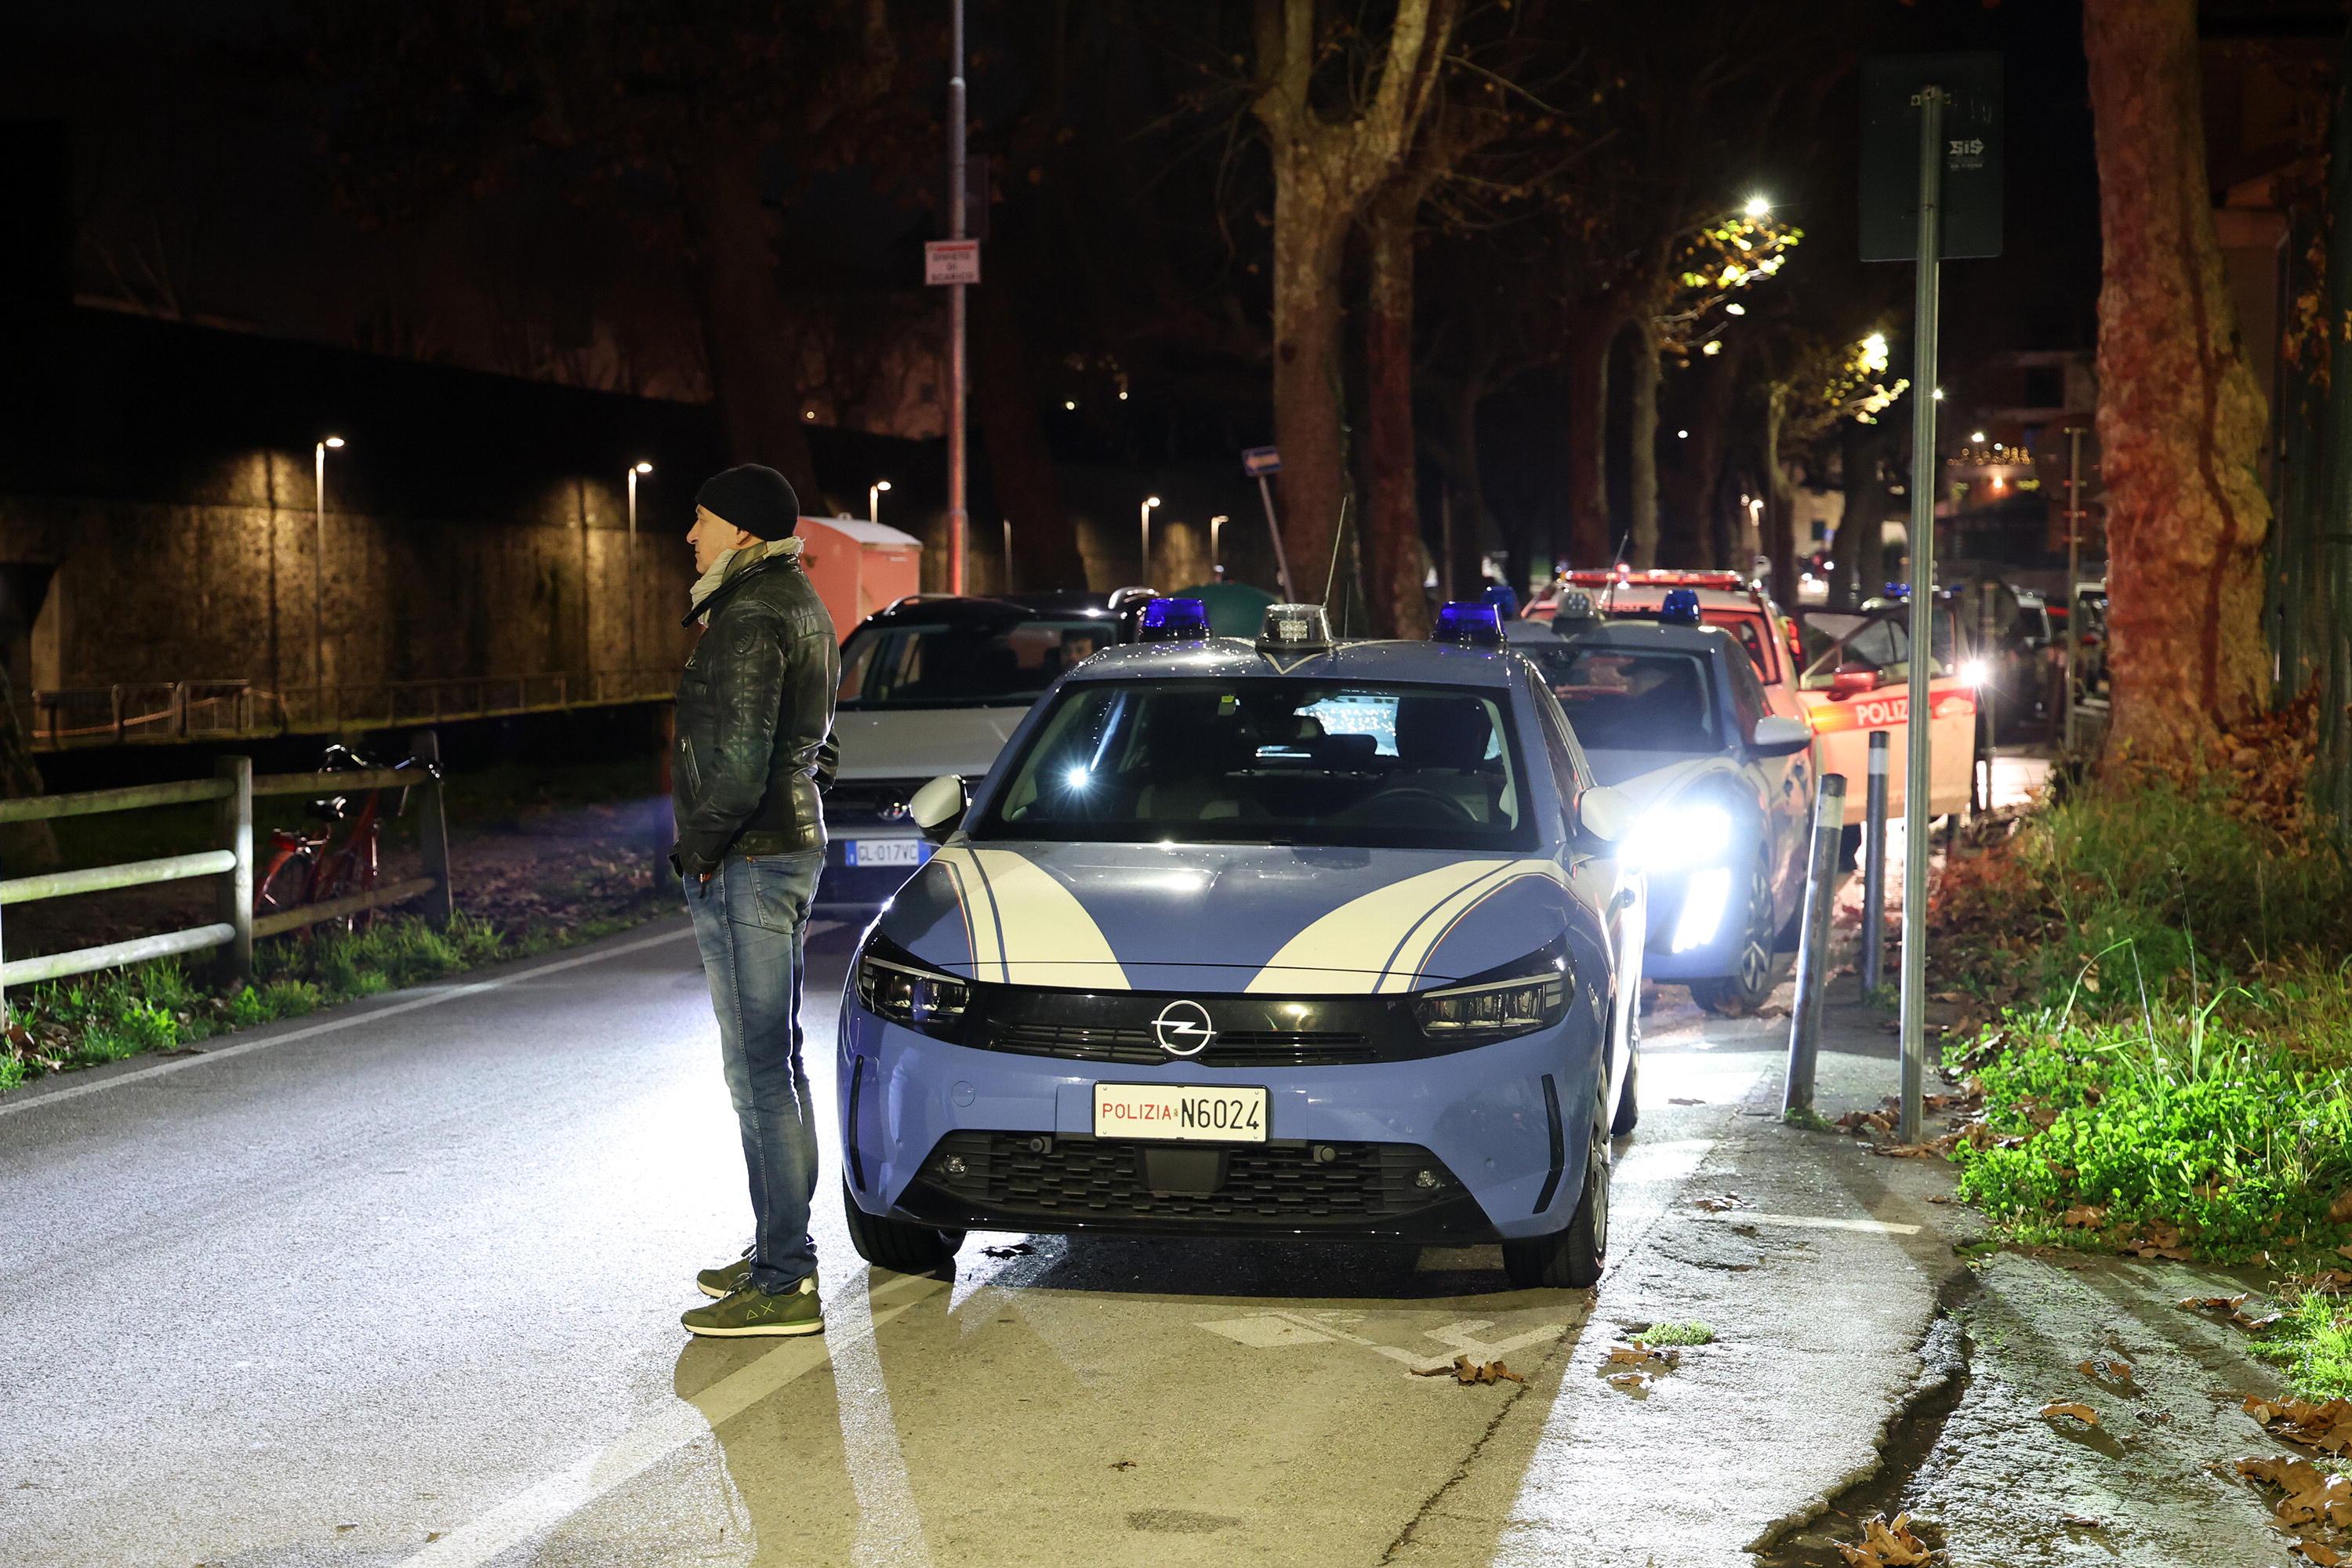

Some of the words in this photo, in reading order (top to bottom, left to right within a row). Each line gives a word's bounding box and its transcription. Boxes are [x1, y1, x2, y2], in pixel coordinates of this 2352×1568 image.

[1855, 698, 1909, 727] POLIZ
[1102, 1102, 1172, 1120] POLIZIA
[1181, 1098, 1260, 1131] N6024
